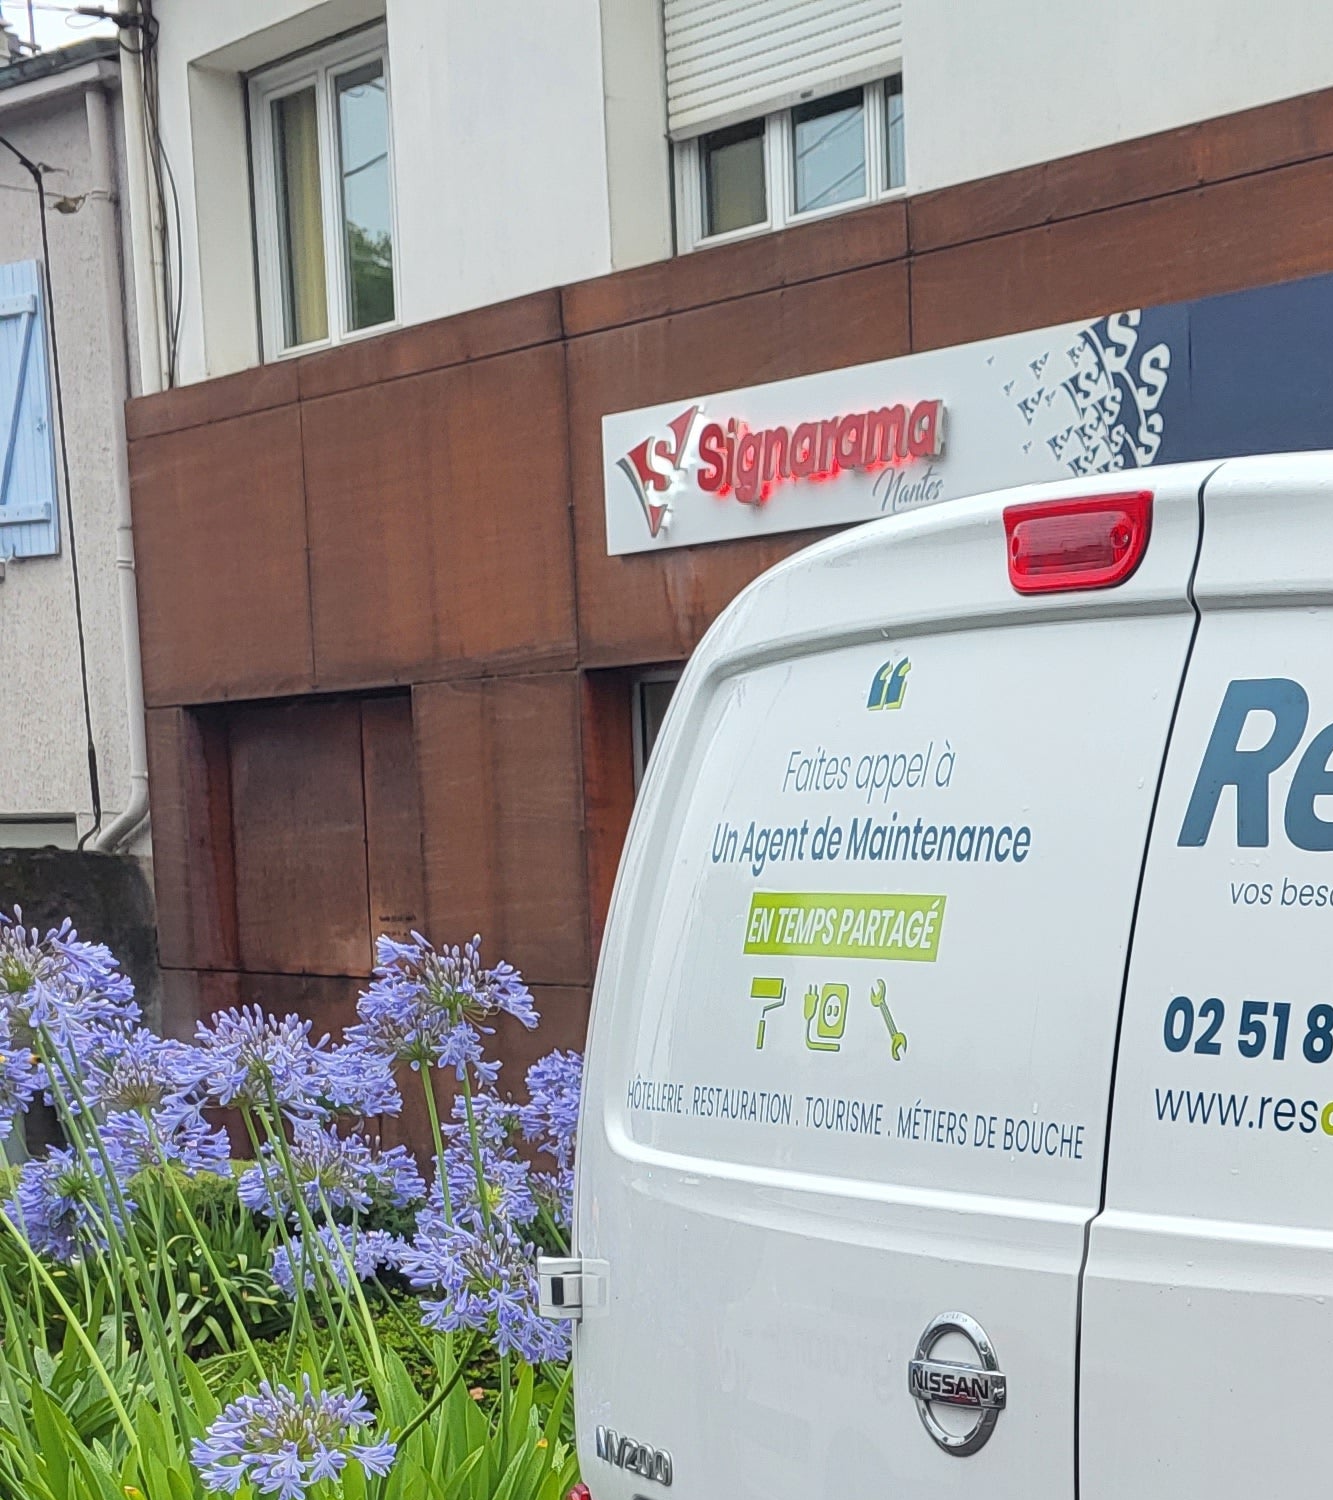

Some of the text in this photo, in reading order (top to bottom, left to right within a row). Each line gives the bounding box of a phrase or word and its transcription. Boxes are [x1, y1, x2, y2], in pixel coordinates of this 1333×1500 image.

[697, 400, 942, 503] Signarama
[872, 466, 944, 512] Nantes
[782, 739, 956, 804] Faites appel à
[711, 811, 1031, 877] Un Agent de Maintenance
[748, 898, 941, 950] EN TEMPS PARTAGÉ
[1229, 879, 1273, 907] vos
[1163, 995, 1226, 1057] 02
[1237, 1000, 1292, 1062] 51
[627, 1075, 1085, 1160] HÔTELLERIE RESTAURATION TOURISME MÉTIERS DE BOUCHE
[911, 1367, 990, 1401] NISSAN
